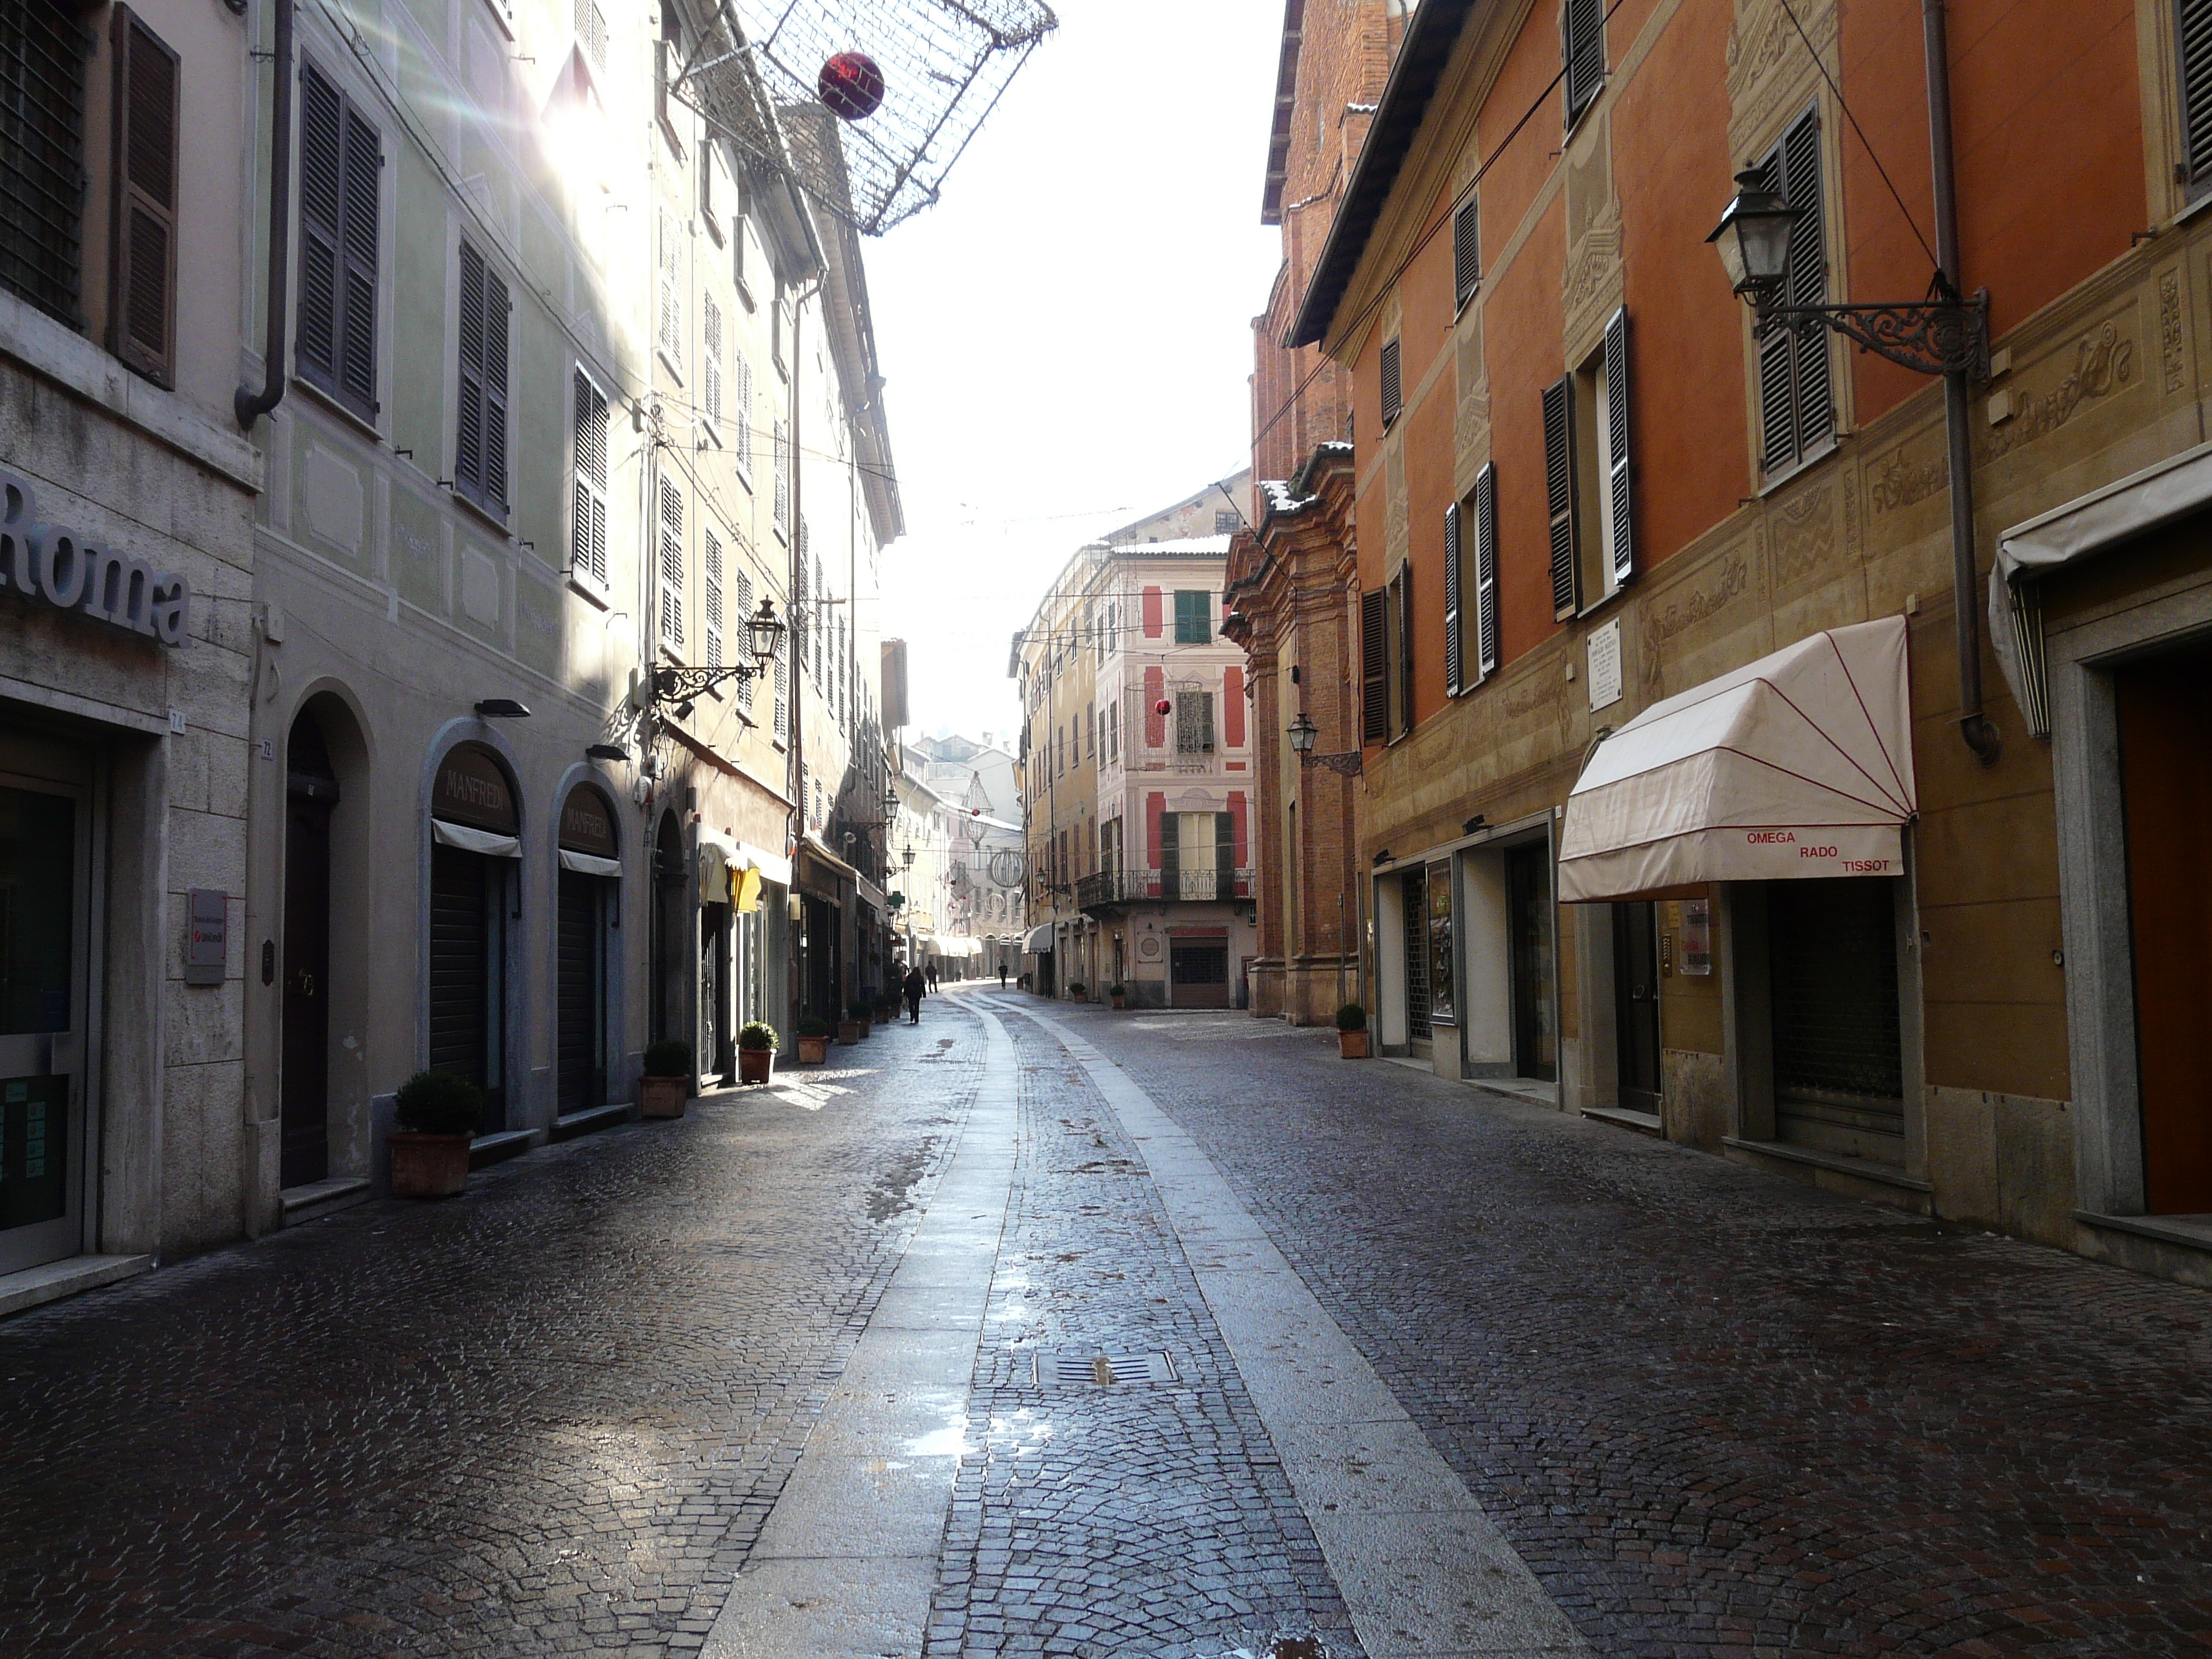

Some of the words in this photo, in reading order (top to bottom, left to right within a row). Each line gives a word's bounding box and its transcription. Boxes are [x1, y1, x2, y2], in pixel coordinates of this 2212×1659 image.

[0, 469, 192, 649] Roma
[171, 713, 183, 731] 74
[264, 740, 271, 756] 72
[446, 769, 504, 810] MANFREDI
[567, 807, 607, 840] MANFREDI
[1747, 832, 1795, 844] OMEGA
[1800, 846, 1838, 858] RADO
[1842, 860, 1889, 872] TISSOT
